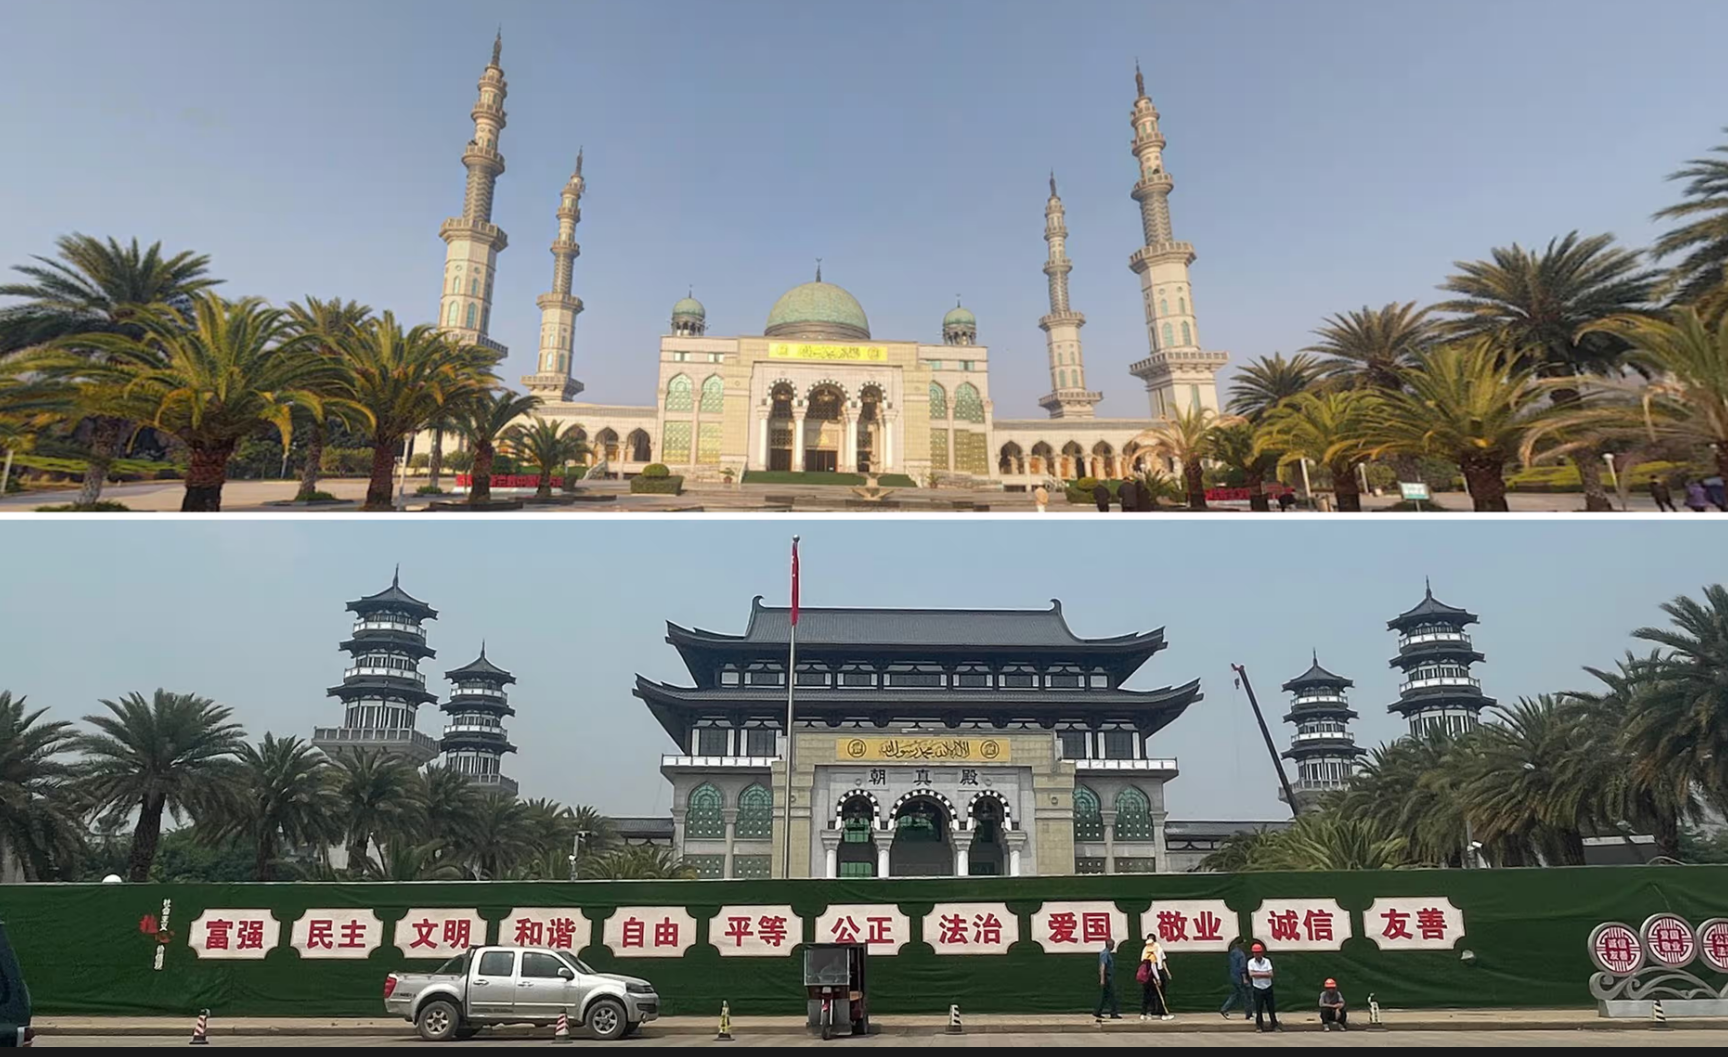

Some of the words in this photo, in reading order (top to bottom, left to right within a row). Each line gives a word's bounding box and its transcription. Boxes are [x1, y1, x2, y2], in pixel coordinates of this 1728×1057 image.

[868, 768, 979, 785] 朝真殿
[205, 920, 264, 949] 富强
[306, 919, 367, 949] 民主
[411, 918, 471, 948] 文明
[514, 918, 576, 949] 和谐
[621, 917, 680, 947] 自由
[724, 916, 786, 947] 平等
[830, 916, 894, 944] 公正
[939, 913, 1003, 944] 法治
[1047, 912, 1112, 943] 爱国
[1156, 911, 1224, 942] 敬业
[1266, 908, 1335, 942] 诚信
[1380, 908, 1448, 940] 友善
